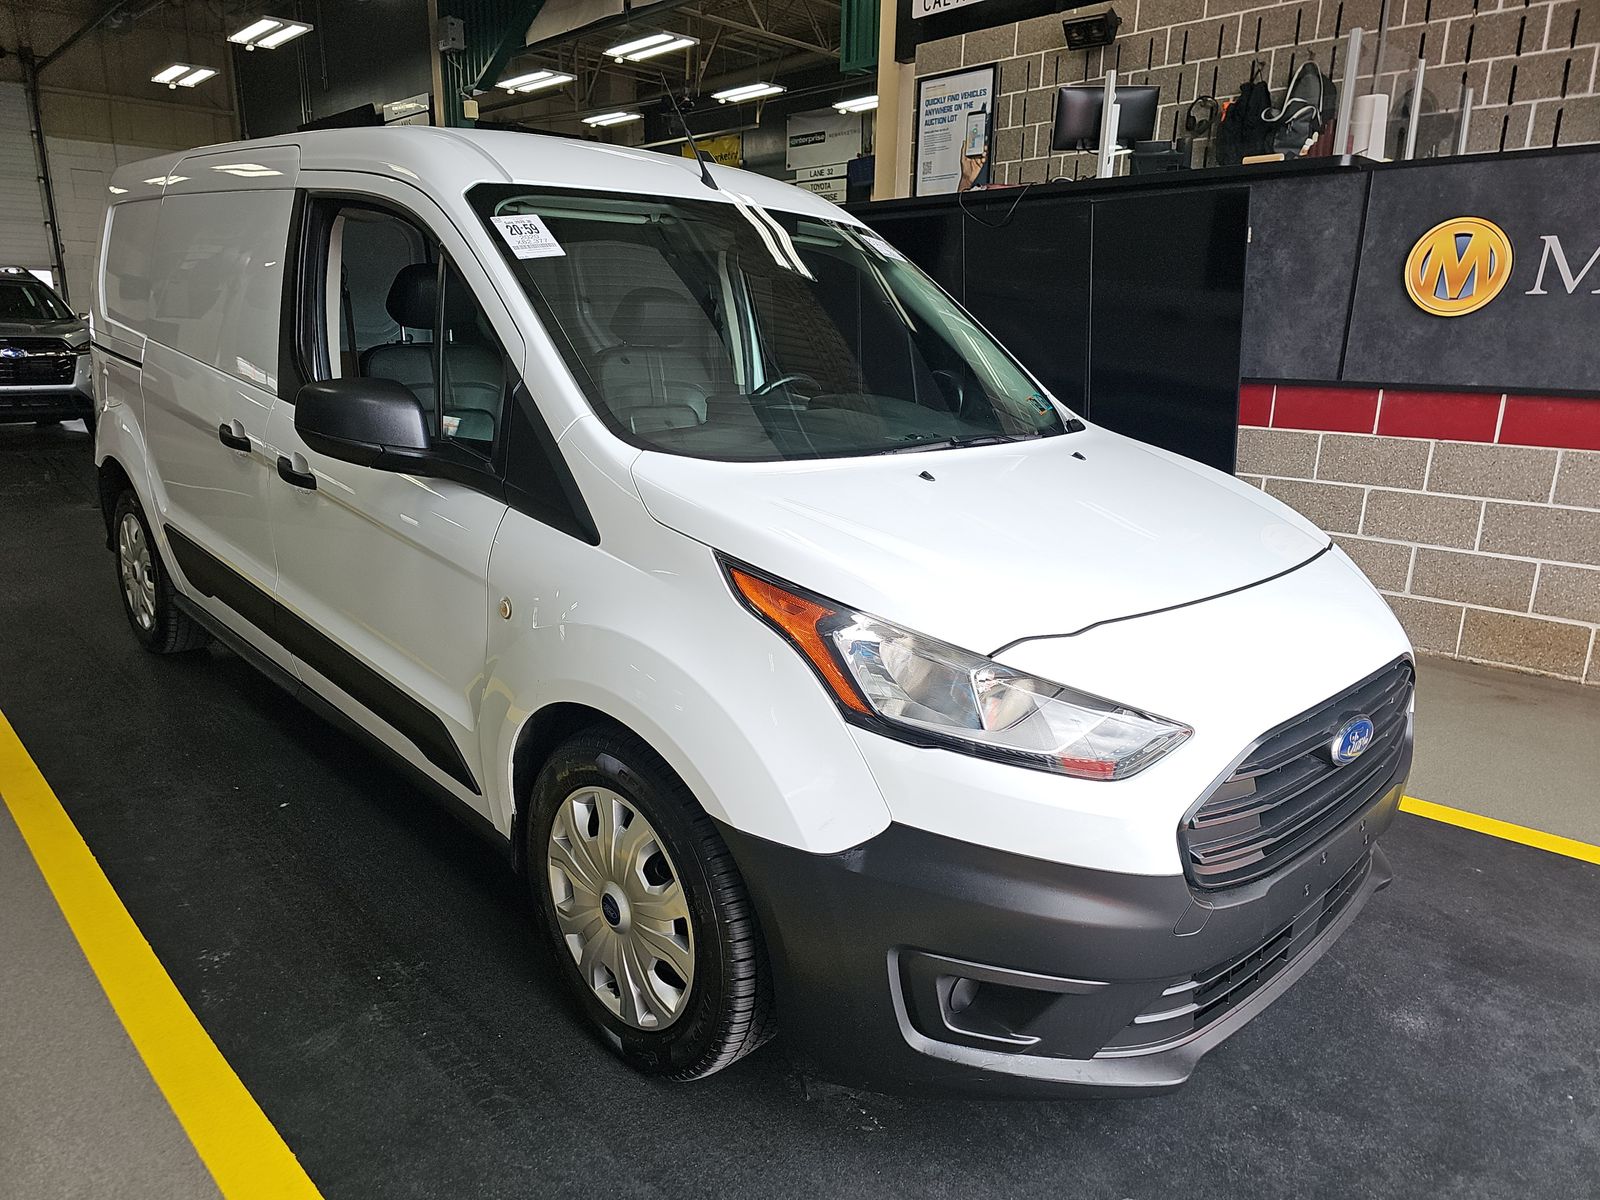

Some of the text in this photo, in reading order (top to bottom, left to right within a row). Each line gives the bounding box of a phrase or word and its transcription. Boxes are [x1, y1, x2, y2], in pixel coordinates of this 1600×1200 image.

[925, 88, 987, 107] QUICKLY FIND VEHICLES
[925, 101, 974, 116] ANYWHERE ON THE
[925, 114, 958, 126] AUCTION LOT
[791, 133, 825, 145] enterprise
[809, 169, 825, 178] LANE
[810, 182, 832, 191] TOYOTA
[505, 223, 540, 236] 20:59
[1346, 727, 1370, 756] Ford
